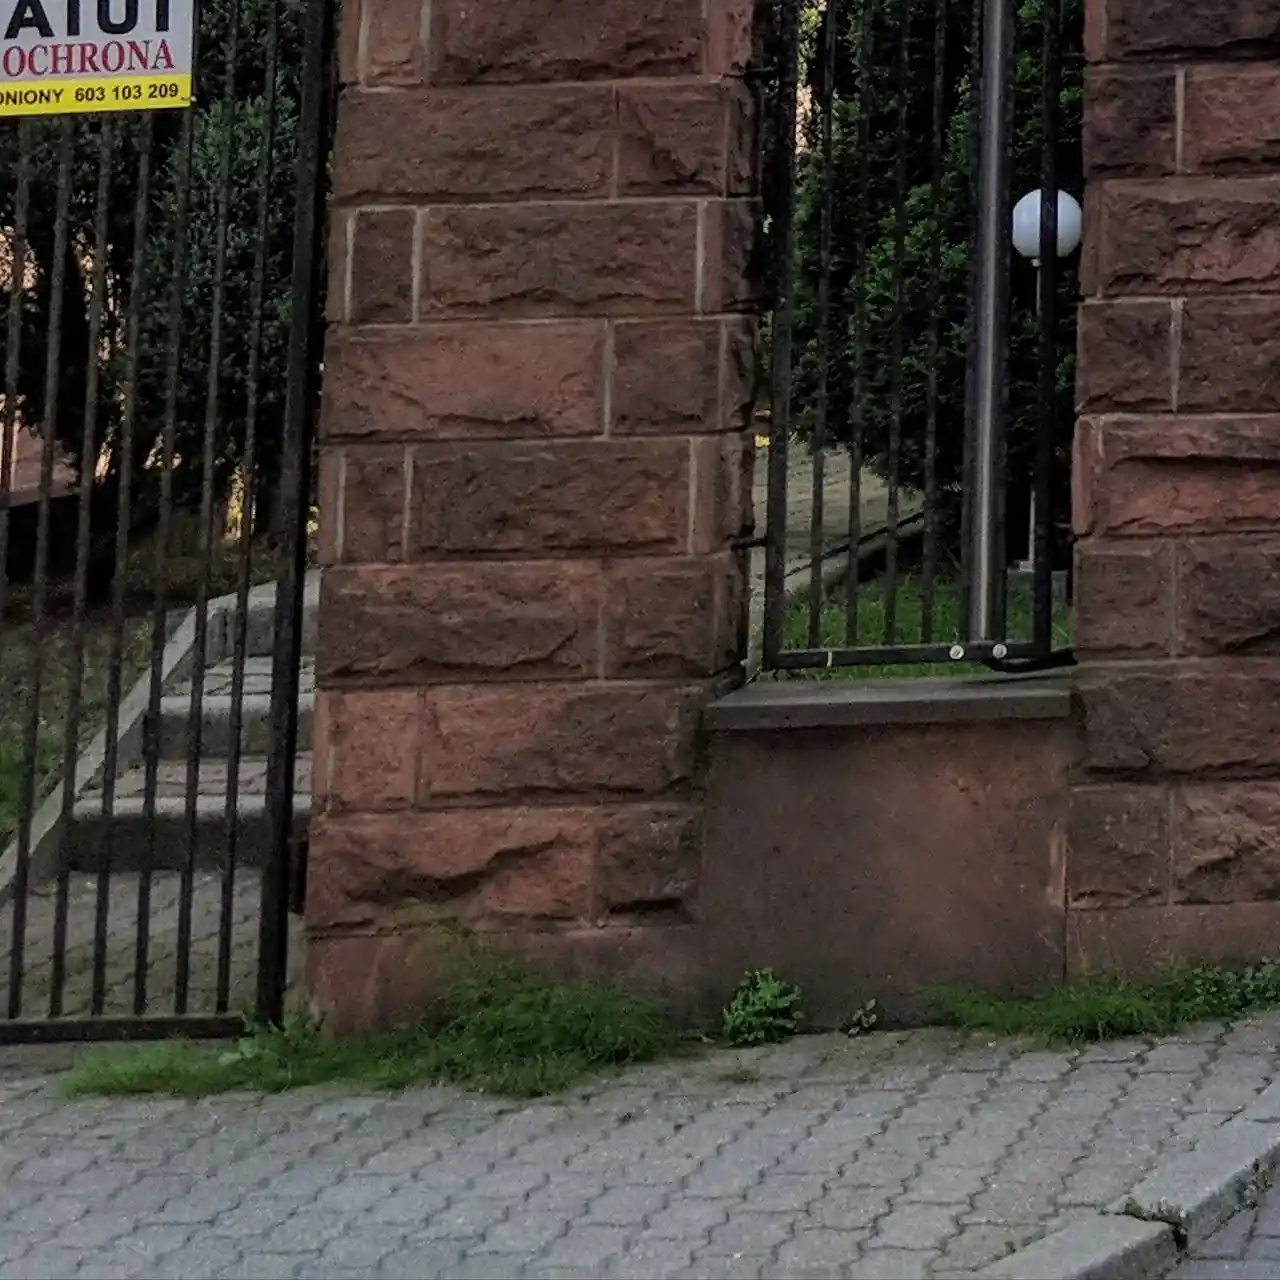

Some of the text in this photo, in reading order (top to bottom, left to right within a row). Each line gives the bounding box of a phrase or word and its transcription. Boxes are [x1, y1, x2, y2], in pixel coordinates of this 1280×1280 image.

[2, 38, 176, 77] OCHRONA
[74, 87, 105, 102] 603
[111, 85, 142, 101] 103
[148, 83, 179, 99] 209
